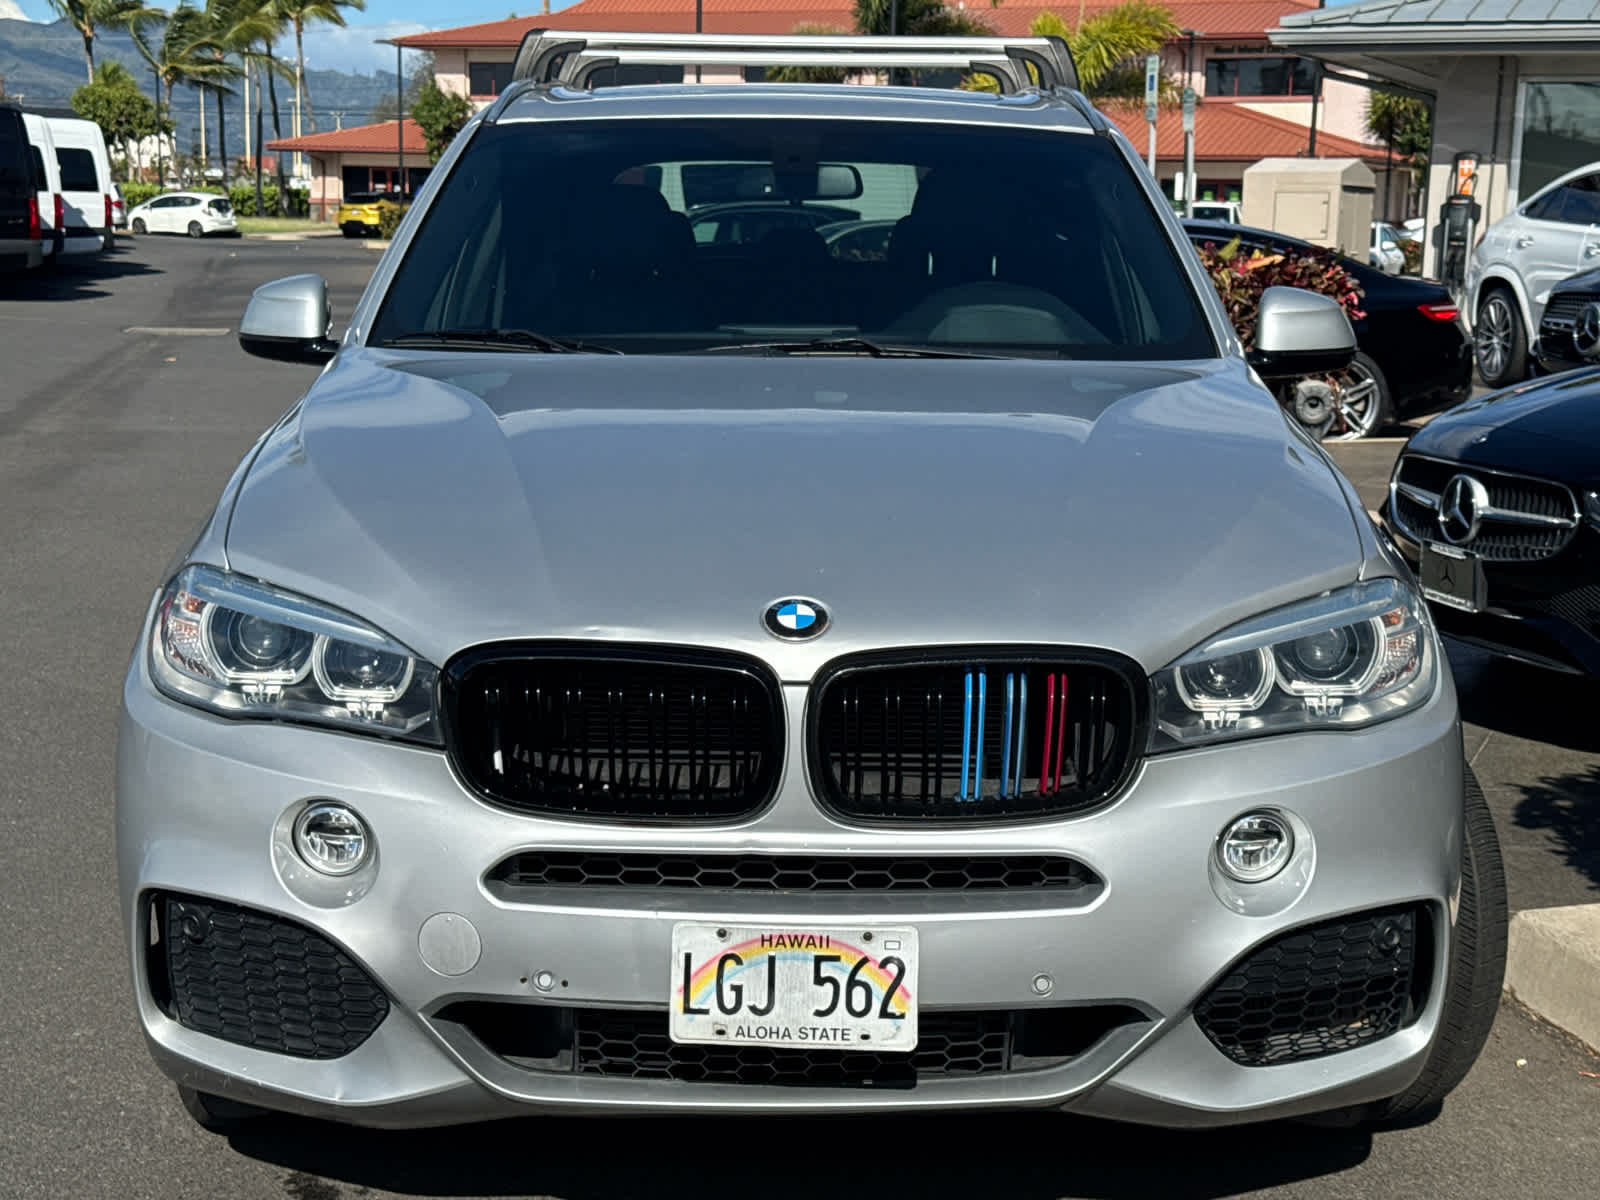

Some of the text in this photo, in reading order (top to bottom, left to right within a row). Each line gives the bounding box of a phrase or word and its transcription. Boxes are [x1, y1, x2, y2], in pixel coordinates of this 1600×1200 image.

[760, 934, 830, 949] HAWAII
[682, 952, 907, 1020] LGJ 562
[735, 1025, 851, 1041] ALOHA STATE
